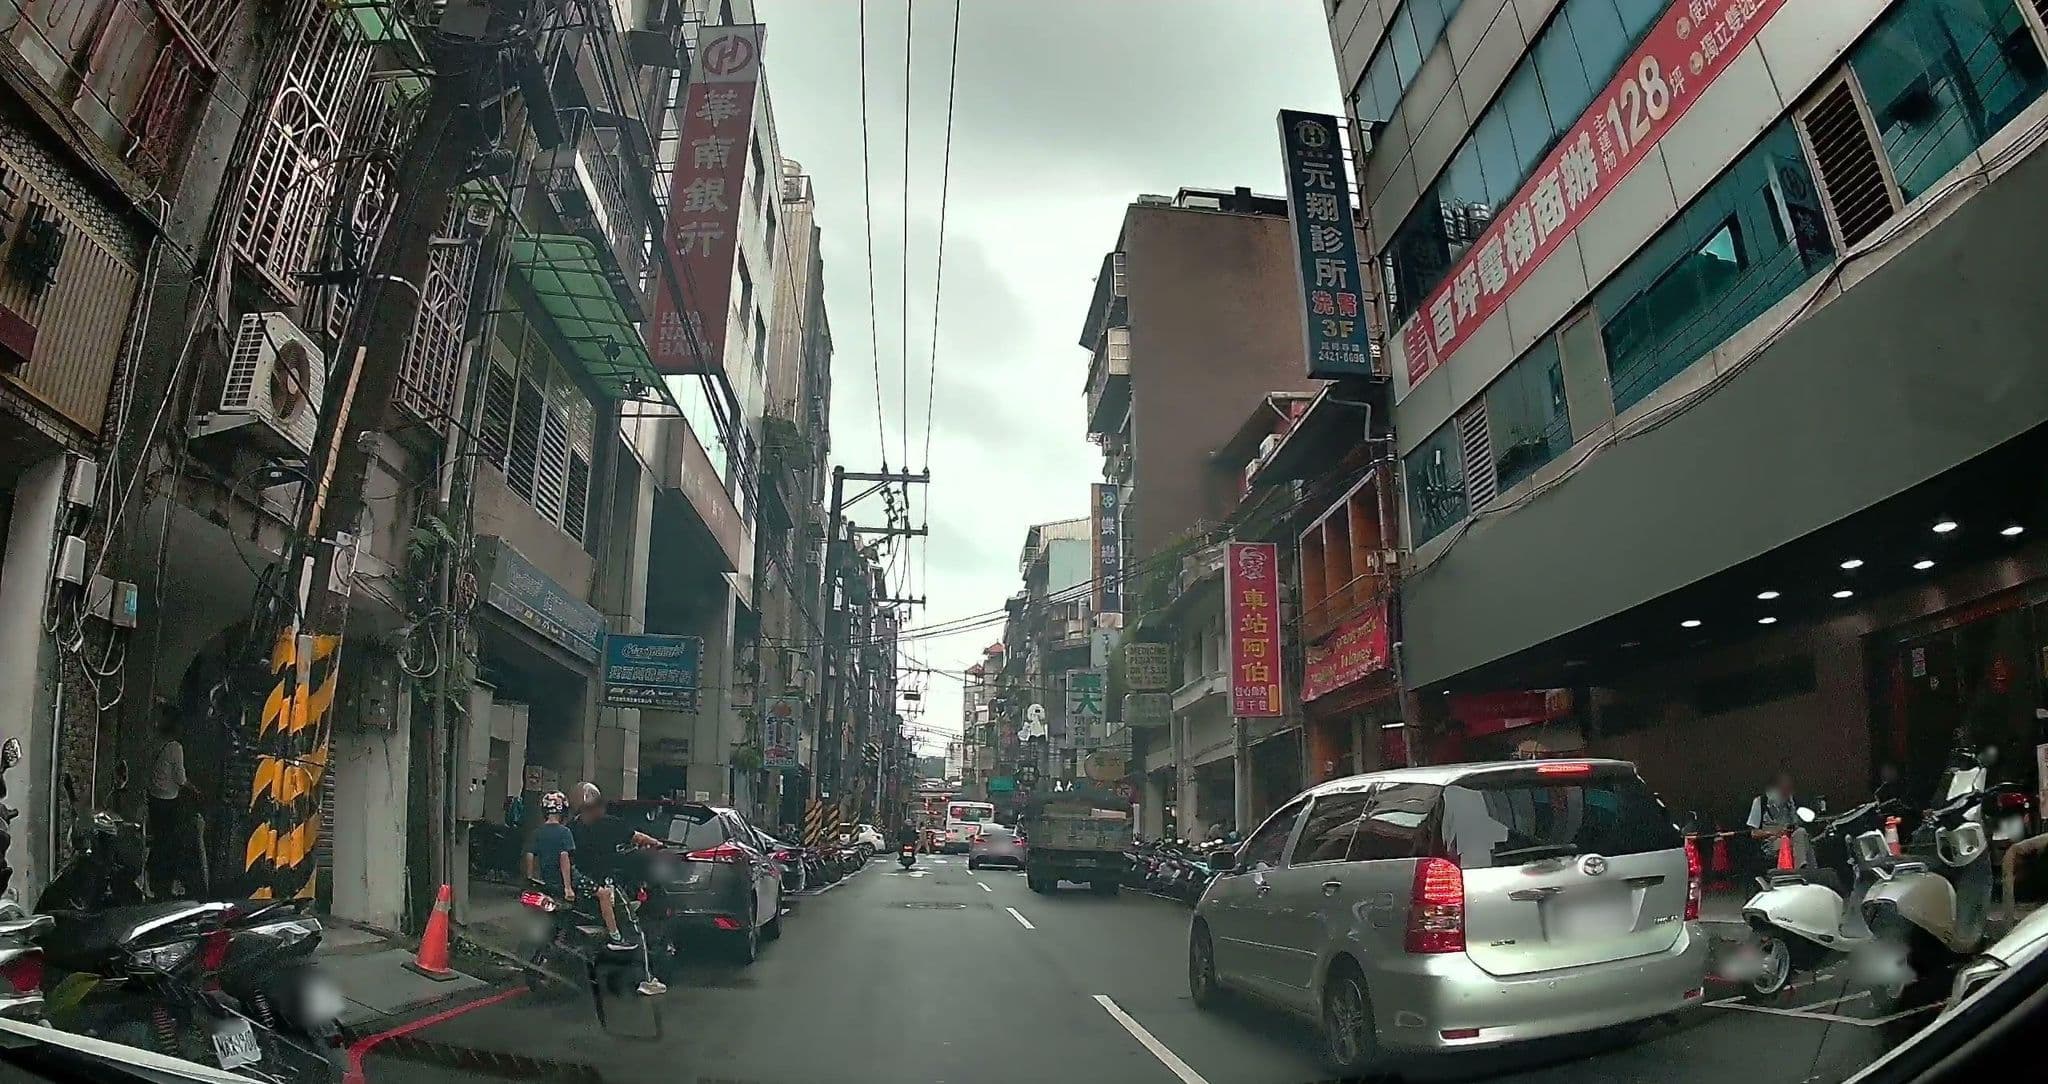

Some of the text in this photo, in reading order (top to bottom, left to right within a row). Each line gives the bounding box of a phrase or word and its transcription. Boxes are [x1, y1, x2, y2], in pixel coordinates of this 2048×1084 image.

[675, 89, 742, 258] 華南銀行
[1302, 161, 1347, 290] 元翔診所
[1322, 319, 1355, 338] 3F
[1240, 588, 1269, 683] 車站阿伯
